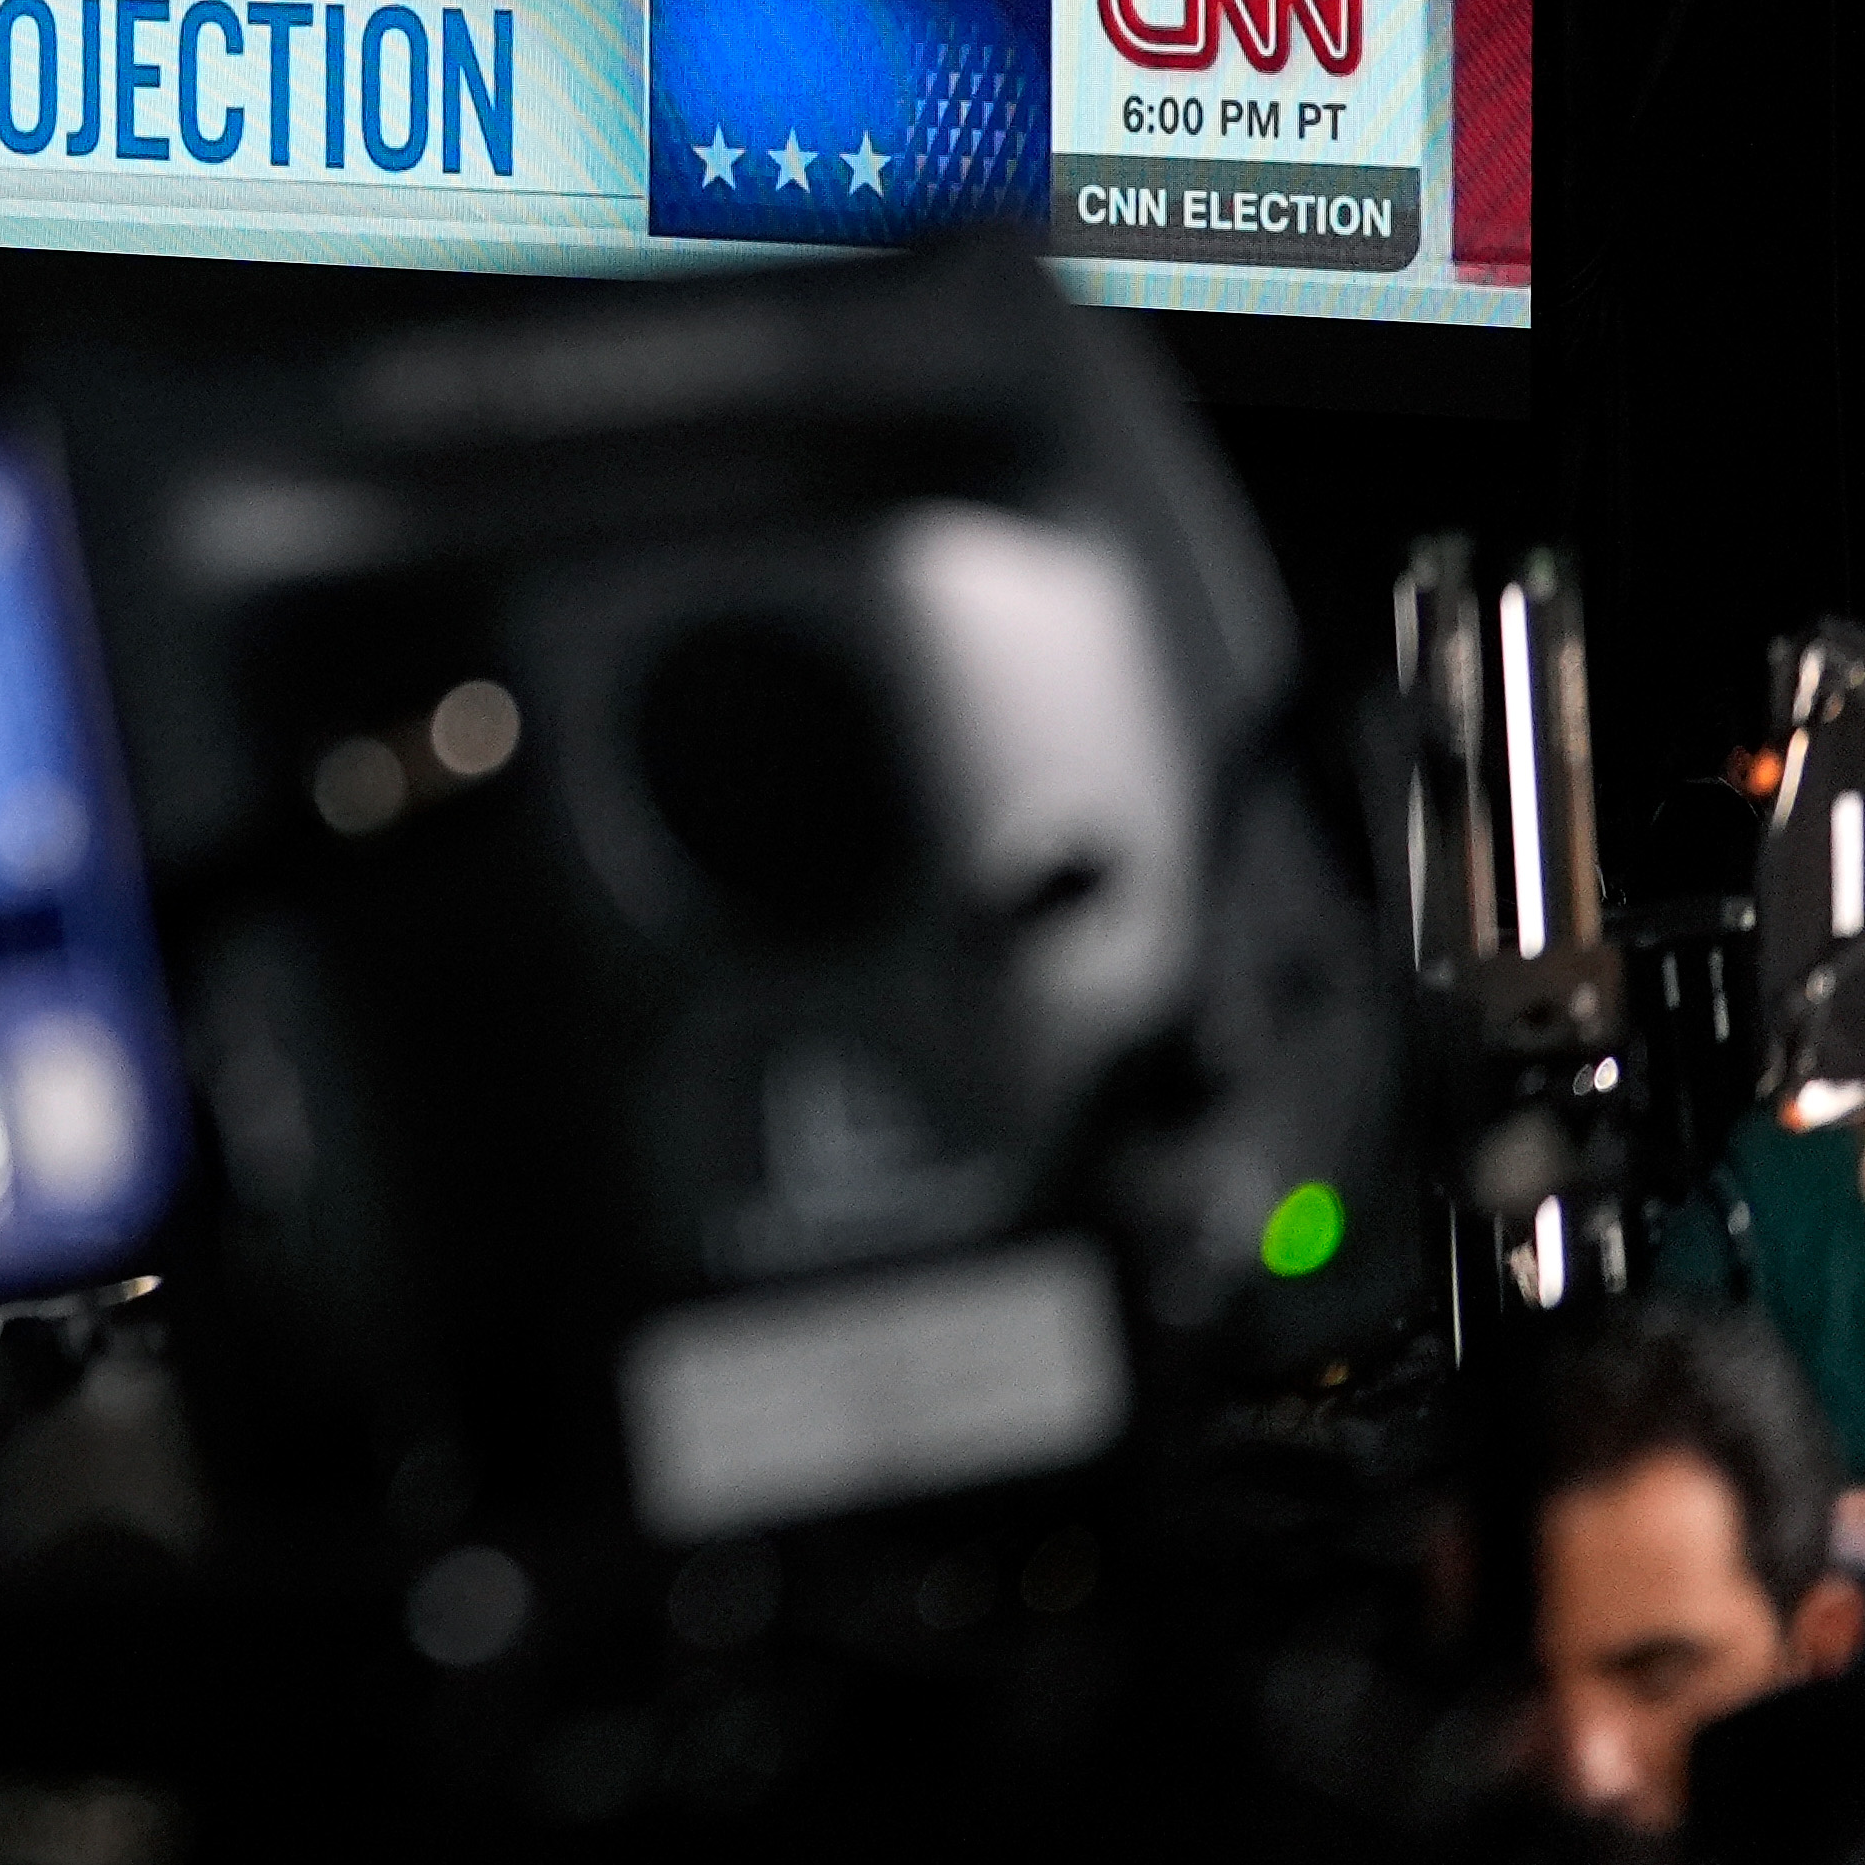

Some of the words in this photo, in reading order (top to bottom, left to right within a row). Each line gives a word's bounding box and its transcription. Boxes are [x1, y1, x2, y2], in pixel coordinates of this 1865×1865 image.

[1122, 95, 1204, 136] 6:00
[1220, 98, 1281, 139] PM
[1297, 102, 1347, 141] PT
[1078, 184, 1167, 228] CNN
[1182, 190, 1392, 238] ELECTION
